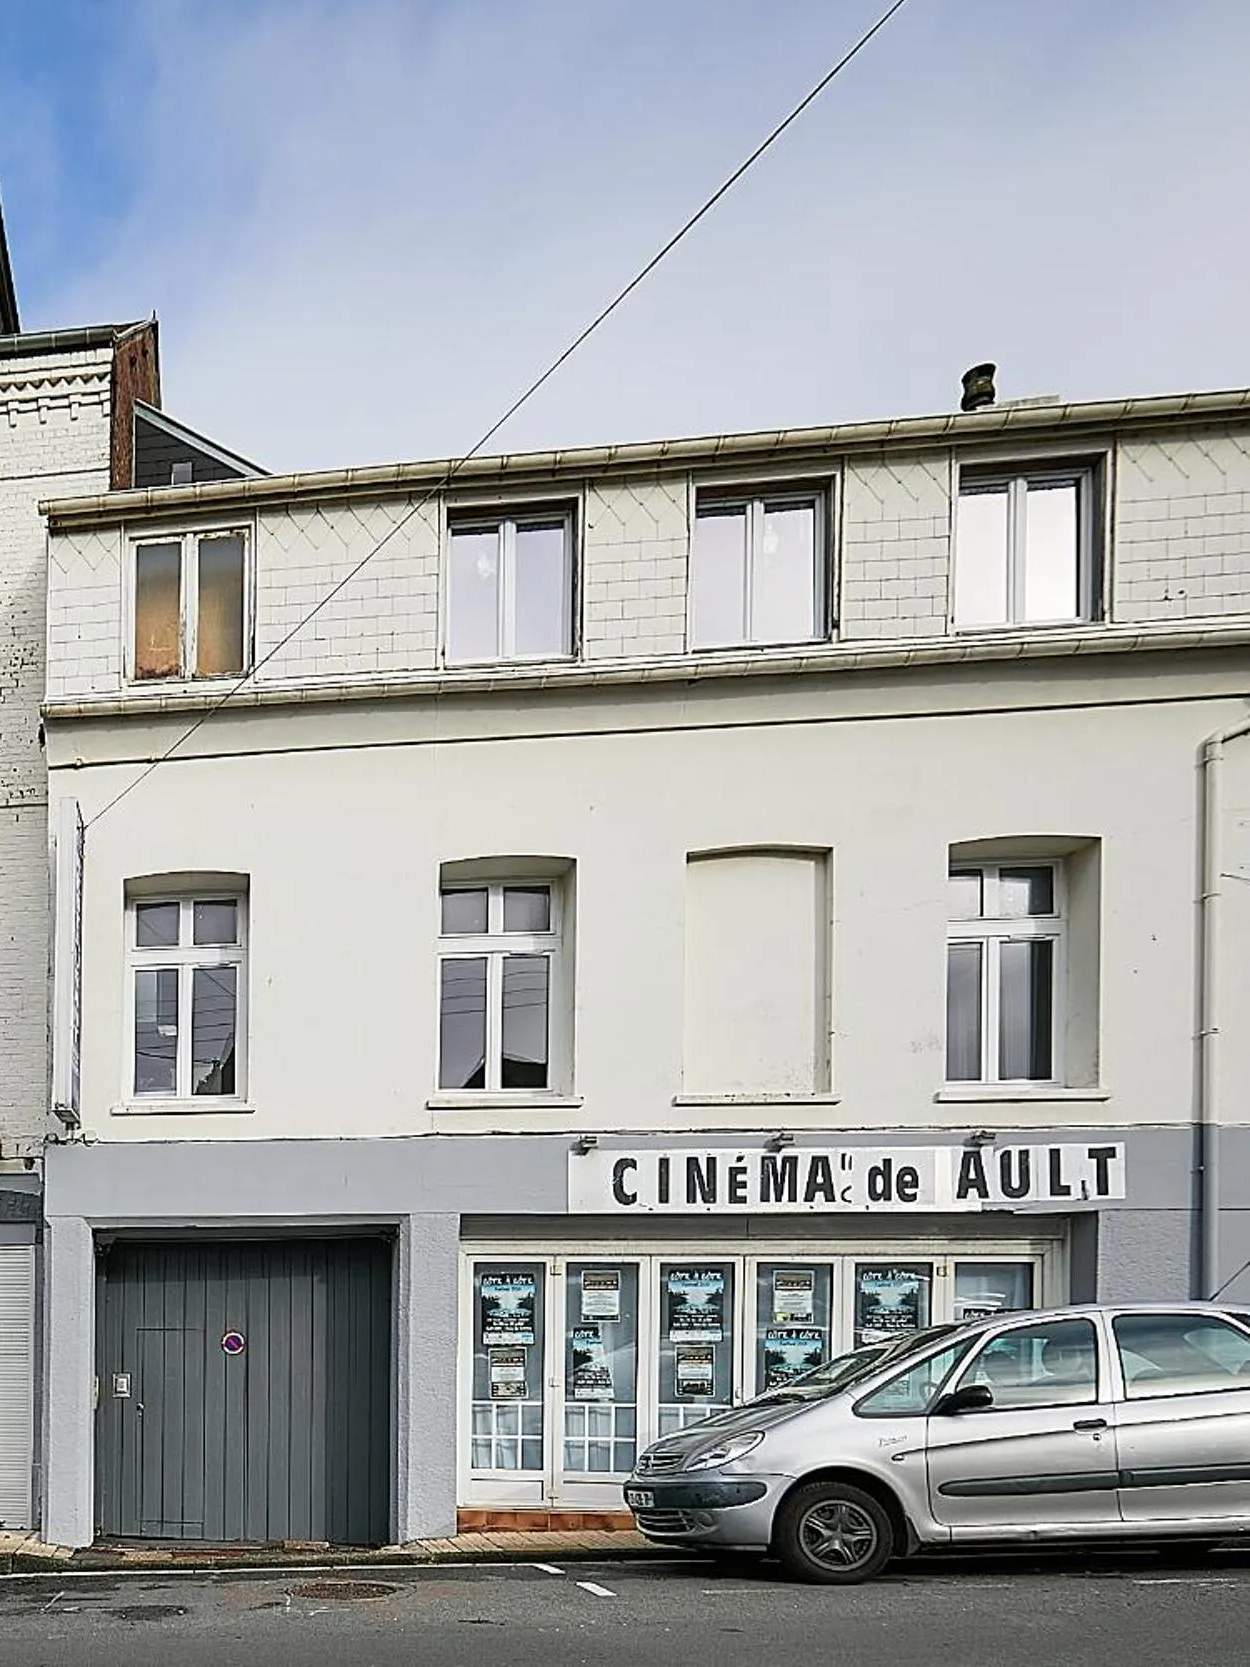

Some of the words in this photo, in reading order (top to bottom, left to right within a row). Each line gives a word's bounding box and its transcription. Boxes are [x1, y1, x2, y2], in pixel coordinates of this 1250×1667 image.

[612, 1155, 837, 1206] CINÉMA
[868, 1157, 919, 1202] de
[956, 1147, 1117, 1199] AULT
